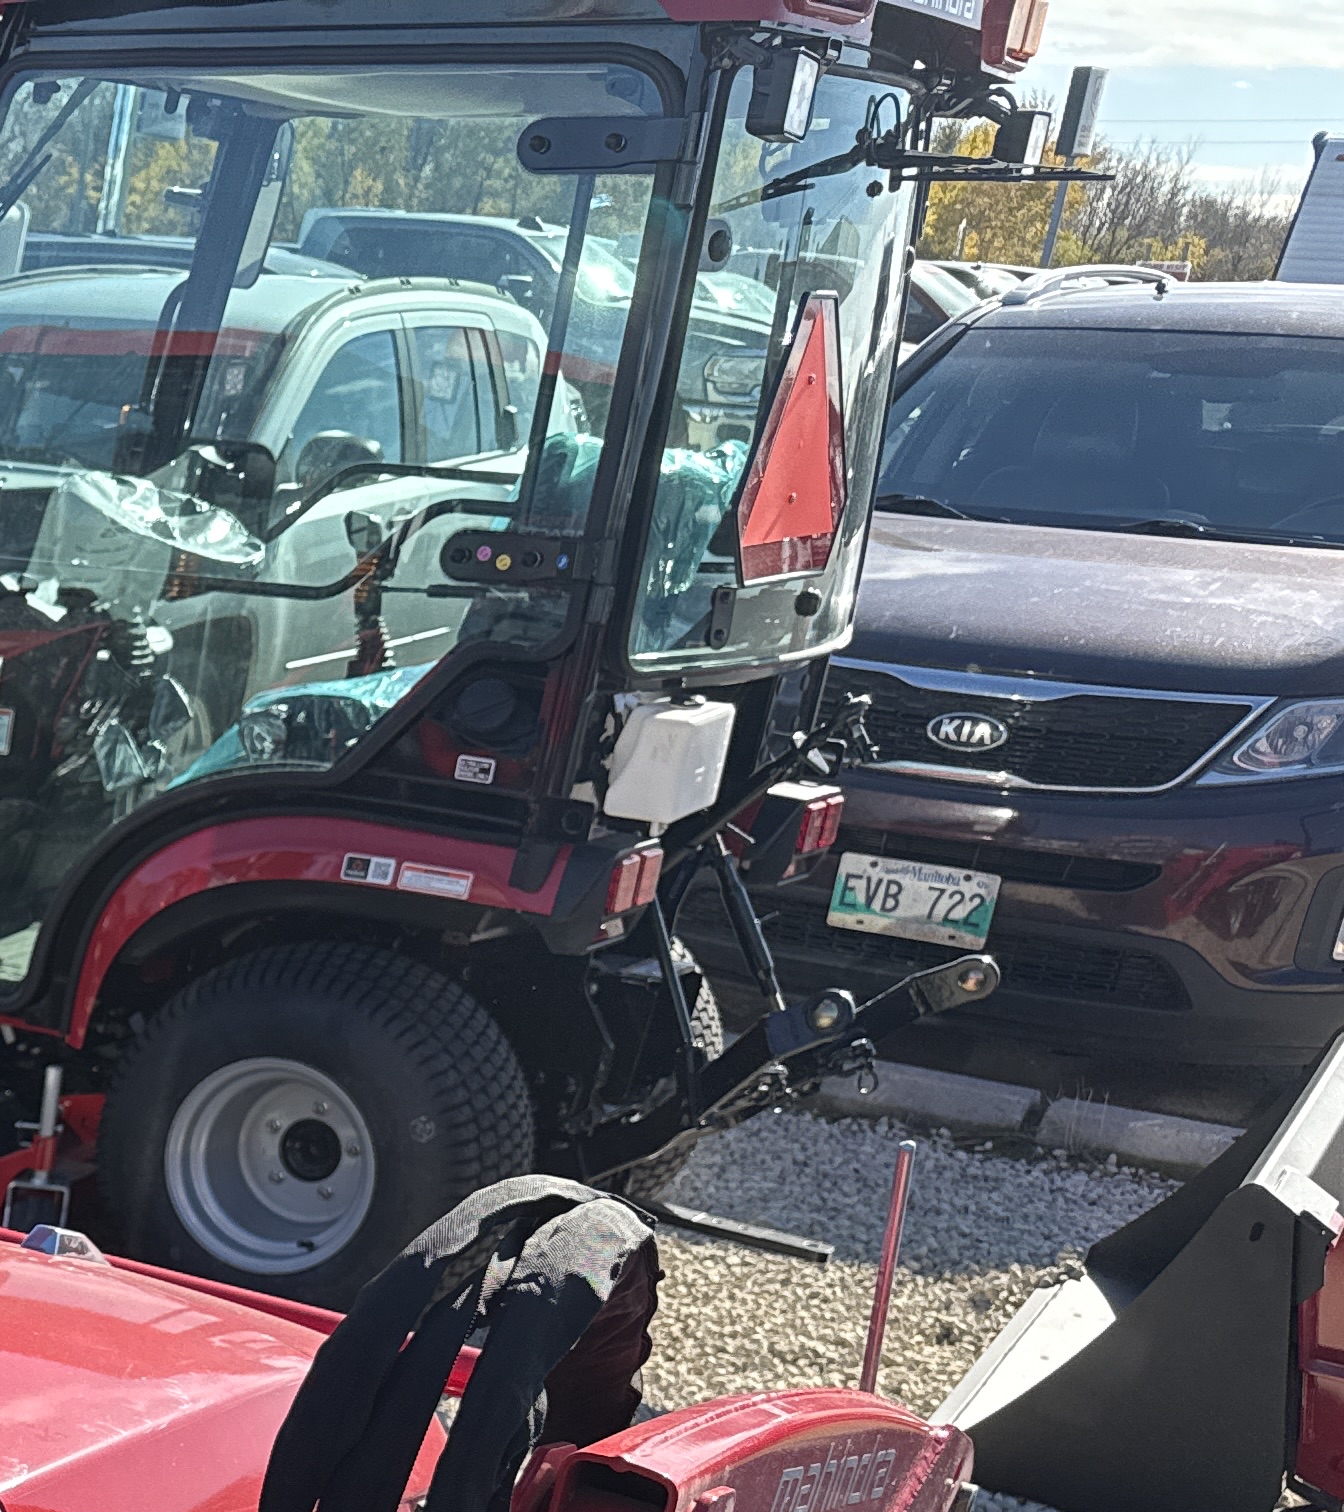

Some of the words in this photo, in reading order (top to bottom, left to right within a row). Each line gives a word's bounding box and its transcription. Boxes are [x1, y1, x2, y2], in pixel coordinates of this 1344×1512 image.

[938, 718, 991, 745] KIA
[912, 865, 961, 887] Manitoba
[838, 872, 903, 913] EVB
[926, 886, 987, 928] 722
